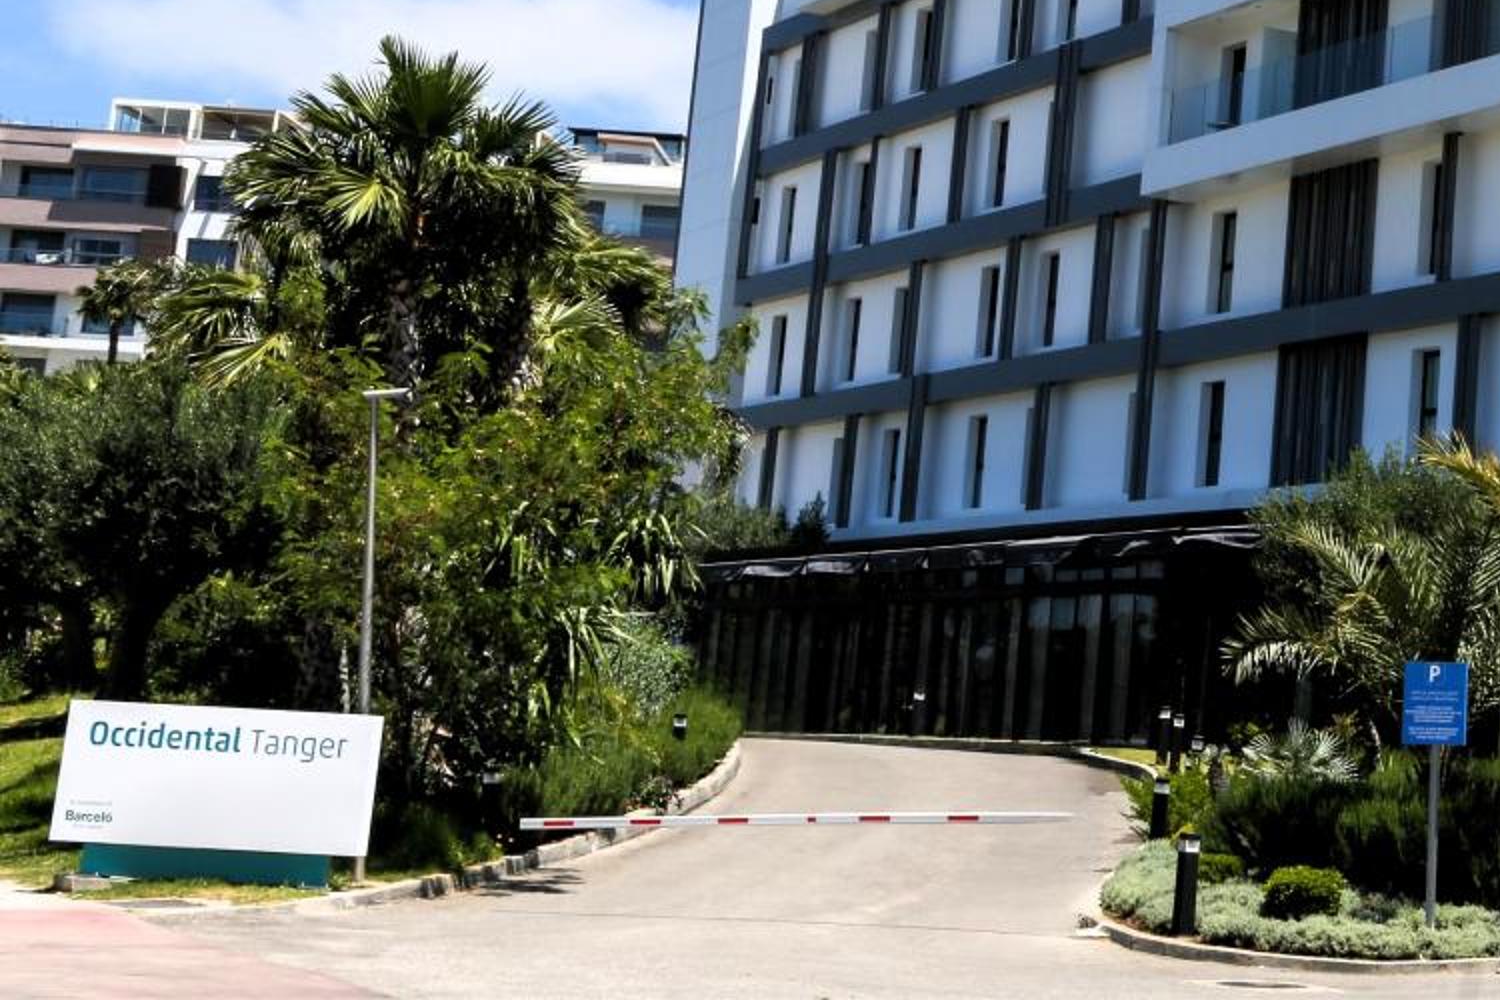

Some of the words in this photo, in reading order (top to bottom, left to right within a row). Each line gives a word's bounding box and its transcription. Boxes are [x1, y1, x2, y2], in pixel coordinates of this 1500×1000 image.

[1428, 664, 1441, 682] P
[89, 720, 241, 753] Occidental
[251, 729, 349, 763] Tanger
